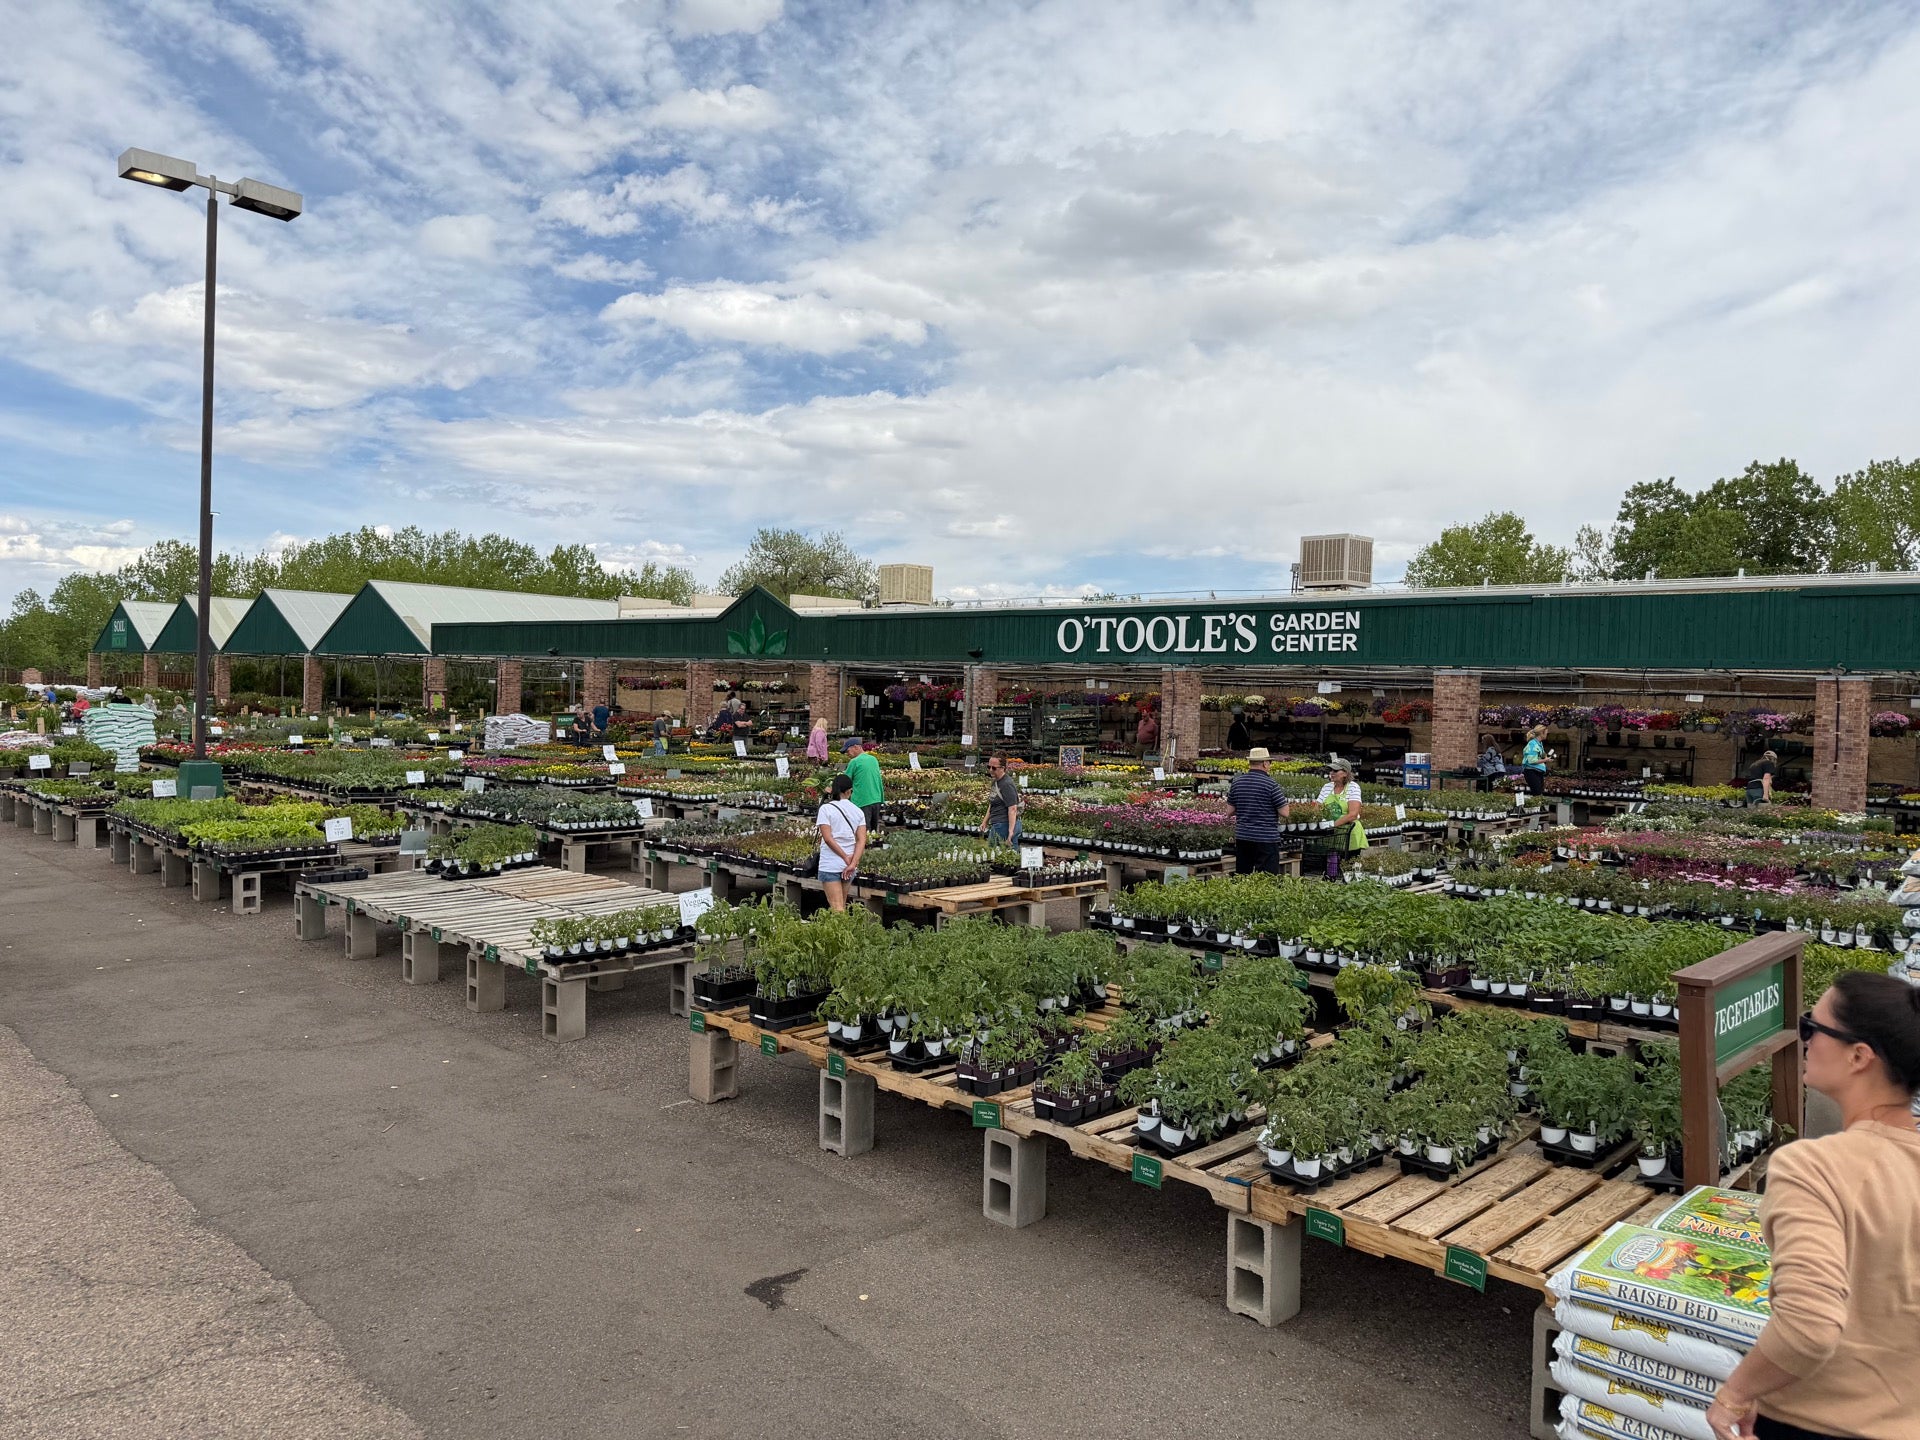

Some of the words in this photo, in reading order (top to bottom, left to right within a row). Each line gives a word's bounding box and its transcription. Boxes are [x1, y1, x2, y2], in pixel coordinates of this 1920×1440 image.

[1057, 613, 1257, 653] O'TOOLE'S
[1270, 611, 1360, 632] GARDEN
[1271, 633, 1358, 652] CENTER
[1677, 1214, 1766, 1245] XFARM
[1617, 1284, 1679, 1311] RAISED
[1684, 1301, 1718, 1323] BED
[1617, 1351, 1677, 1381] RAISED
[1683, 1370, 1717, 1393] BED
